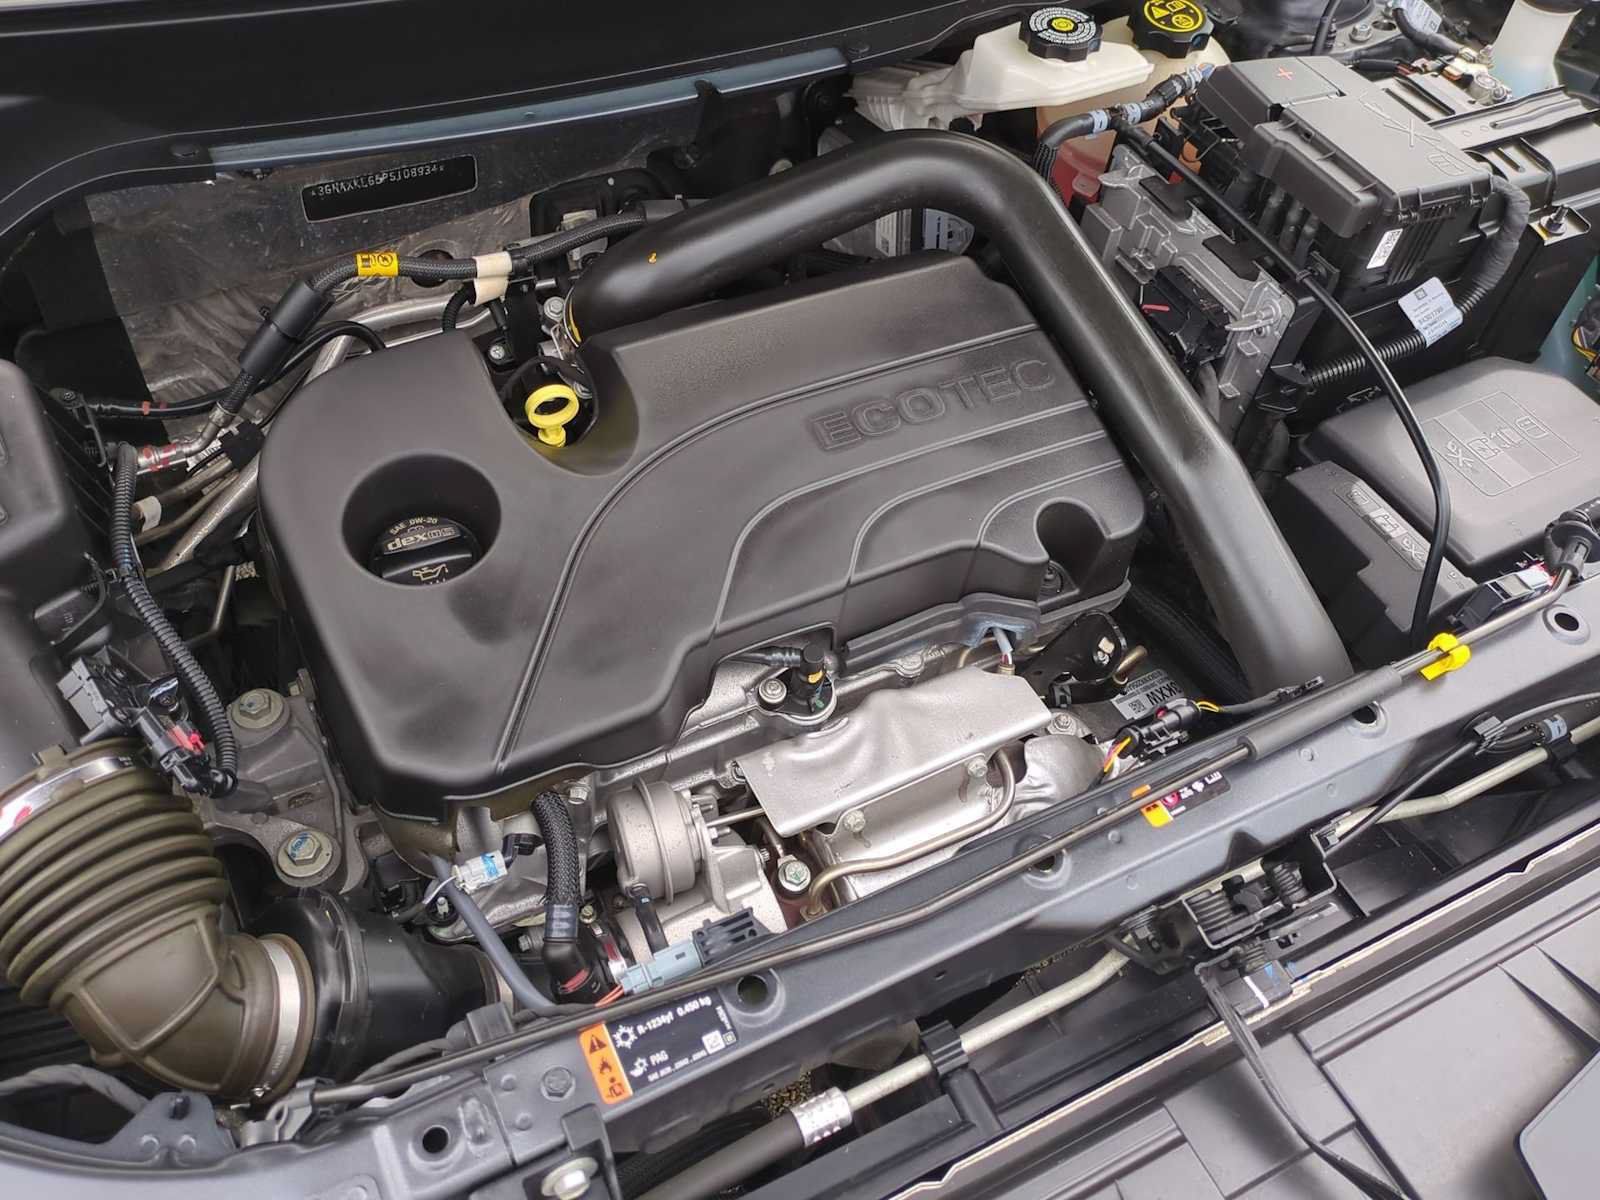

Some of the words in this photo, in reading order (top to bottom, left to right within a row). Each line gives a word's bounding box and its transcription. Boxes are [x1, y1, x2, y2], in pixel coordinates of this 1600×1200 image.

[807, 359, 1056, 451] ECOTEC
[387, 526, 457, 551] dexos
[390, 522, 407, 535] SAE
[649, 1049, 669, 1066] PAG
